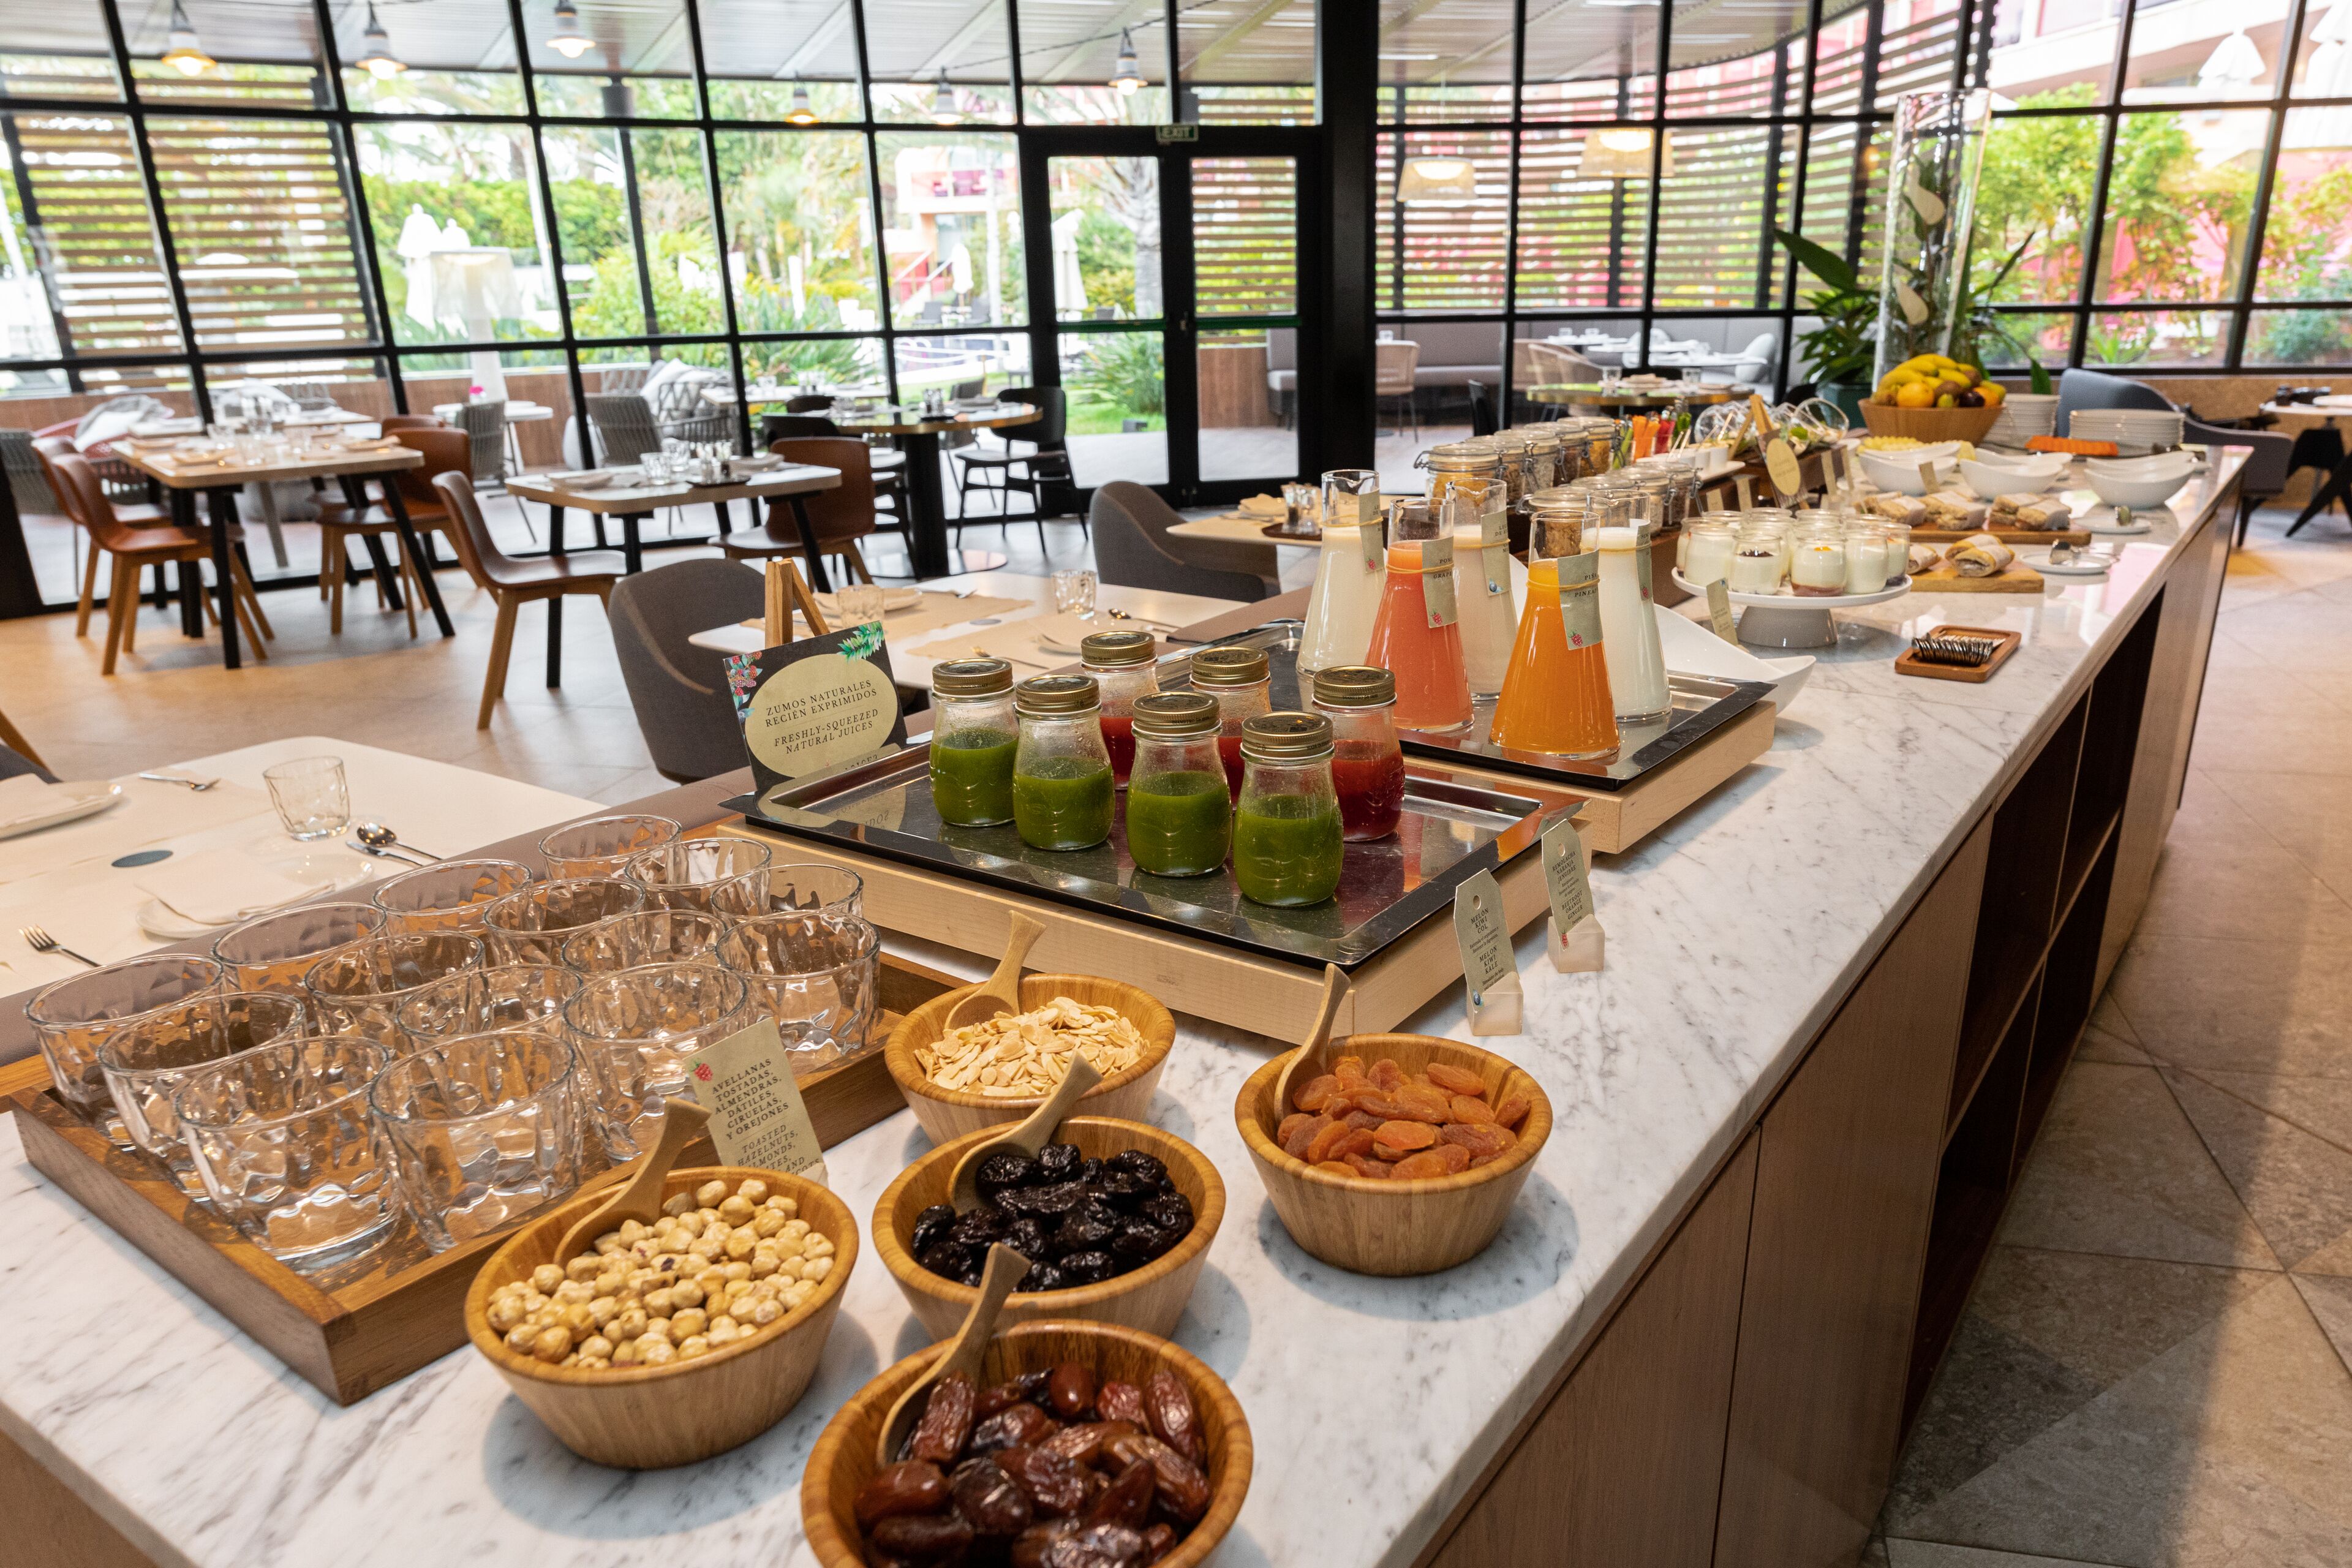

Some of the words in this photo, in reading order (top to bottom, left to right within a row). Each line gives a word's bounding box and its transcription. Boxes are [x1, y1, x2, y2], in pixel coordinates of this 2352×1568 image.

[1162, 127, 1189, 138] EXIT
[765, 707, 807, 727] RECIÉN
[812, 688, 877, 714] EXPRIMIDOS
[766, 698, 807, 716] ZUMOS
[810, 680, 872, 704] NATURALES
[774, 709, 878, 747] FRESHLY-SQUEEZED
[785, 731, 835, 754] NATURAL
[838, 720, 873, 738] JUICES
[1552, 851, 1576, 872] REMOLACHA
[1556, 859, 1574, 875] NARANJA
[1558, 865, 1577, 884] JENGIBRE
[1562, 890, 1582, 910] BEETROOT
[1566, 898, 1582, 913] ORANGE
[1568, 905, 1583, 919] GINGER
[1475, 916, 1487, 928] KIWI
[1477, 924, 1488, 933] COL
[1480, 945, 1497, 962] MELON
[1484, 954, 1496, 967] KIWI
[1485, 961, 1498, 974] KALE
[712, 1058, 771, 1095] AVELLANAS
[726, 1131, 733, 1140] Y
[736, 1102, 789, 1134] OREJONES
[737, 1130, 798, 1166] HAZELNUTS,
[742, 1125, 786, 1153] TOASTED
[785, 1156, 805, 1172] AND
